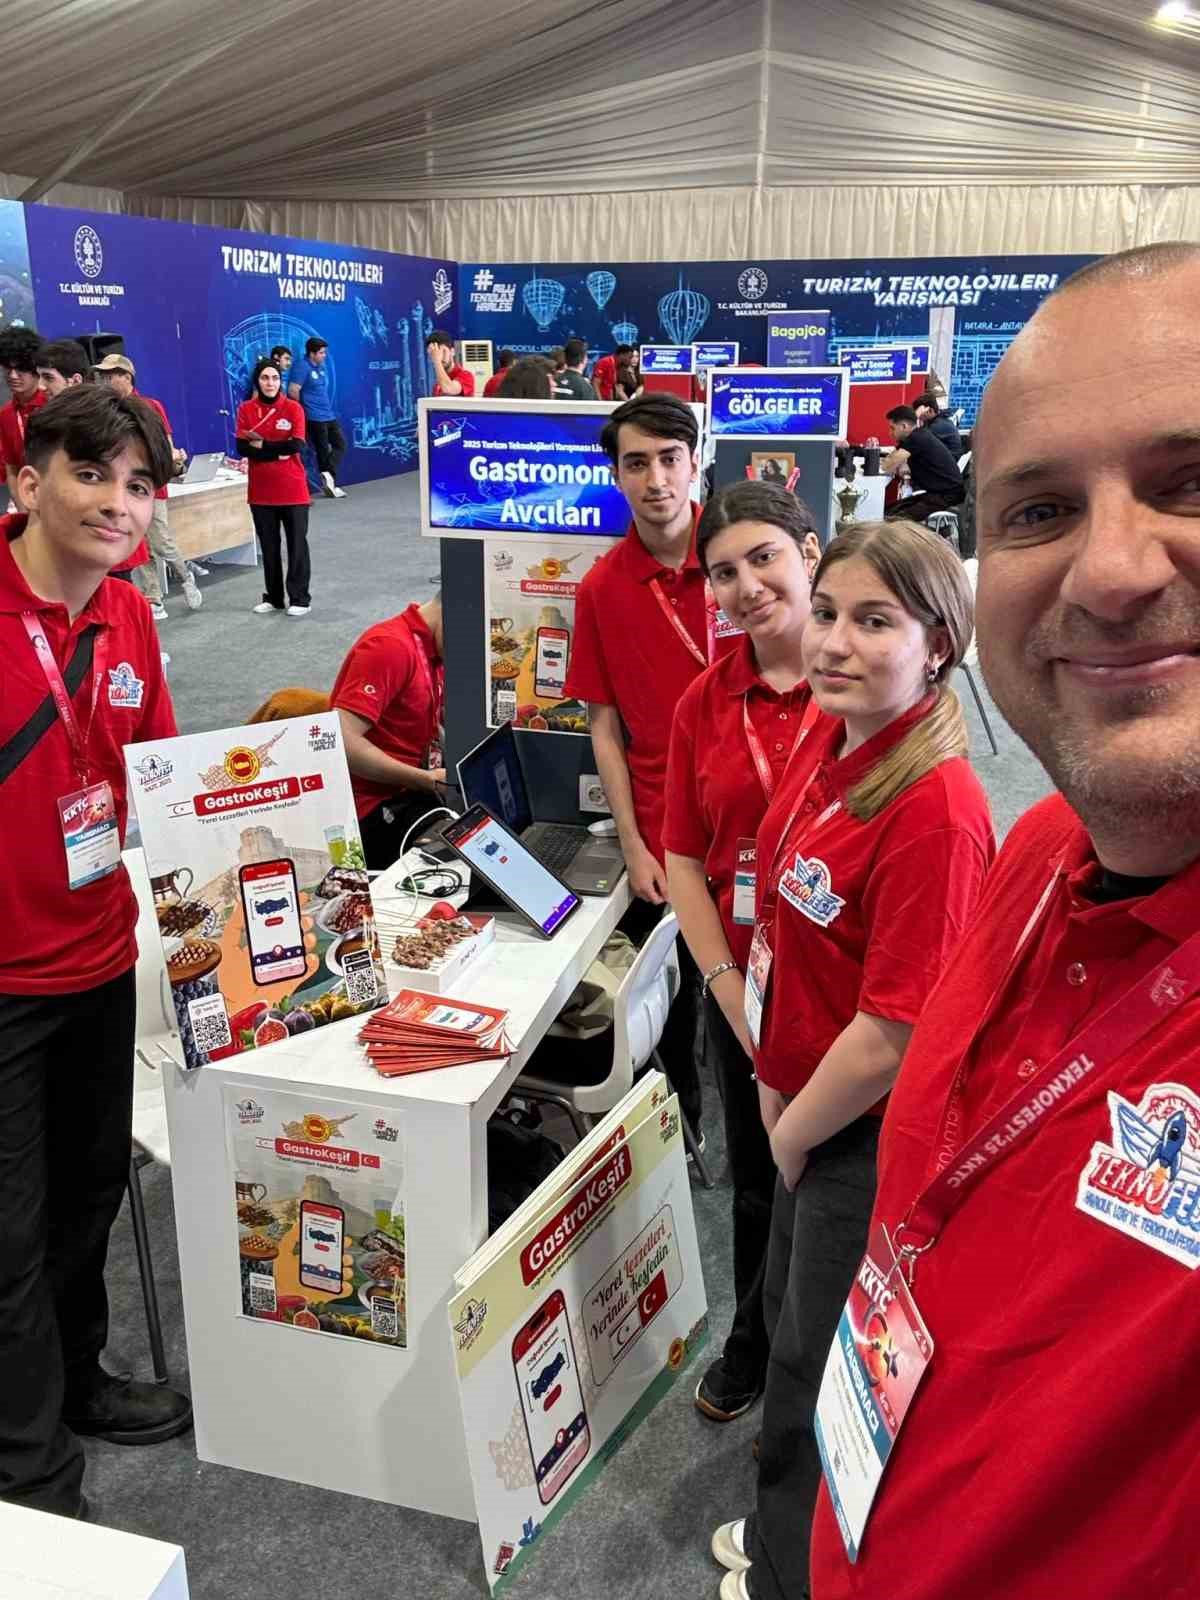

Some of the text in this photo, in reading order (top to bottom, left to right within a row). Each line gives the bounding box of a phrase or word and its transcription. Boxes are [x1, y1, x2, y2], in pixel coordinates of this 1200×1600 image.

[60, 284, 71, 293] T.C.
[72, 282, 94, 294] KÜLTÜR
[95, 284, 103, 294] VE
[278, 278, 346, 304] YARIŞMASI
[874, 290, 980, 308] YARIŞMASI
[729, 302, 753, 310] KÜLTÜR
[754, 302, 762, 310] VE
[771, 324, 826, 340] BagajGo
[728, 394, 822, 415] GÖLGELER
[463, 440, 481, 448] 2025
[592, 444, 605, 452] Lis
[470, 455, 616, 486] Gastronom
[500, 498, 600, 527] Avcıları
[63, 795, 89, 823] KKTC
[204, 782, 290, 809] GastroKeşif
[739, 851, 756, 862] KK
[946, 1053, 1095, 1188] TEKNOFEST'25 KKTC
[282, 1142, 351, 1163] GastroKeşif
[1088, 1153, 1200, 1232] TEKNOFE
[529, 1151, 626, 1271] GastroKeşif
[858, 1262, 892, 1313] KKTC
[590, 1290, 629, 1341] Yerinde
[844, 1334, 880, 1436] YARIŞMACI
